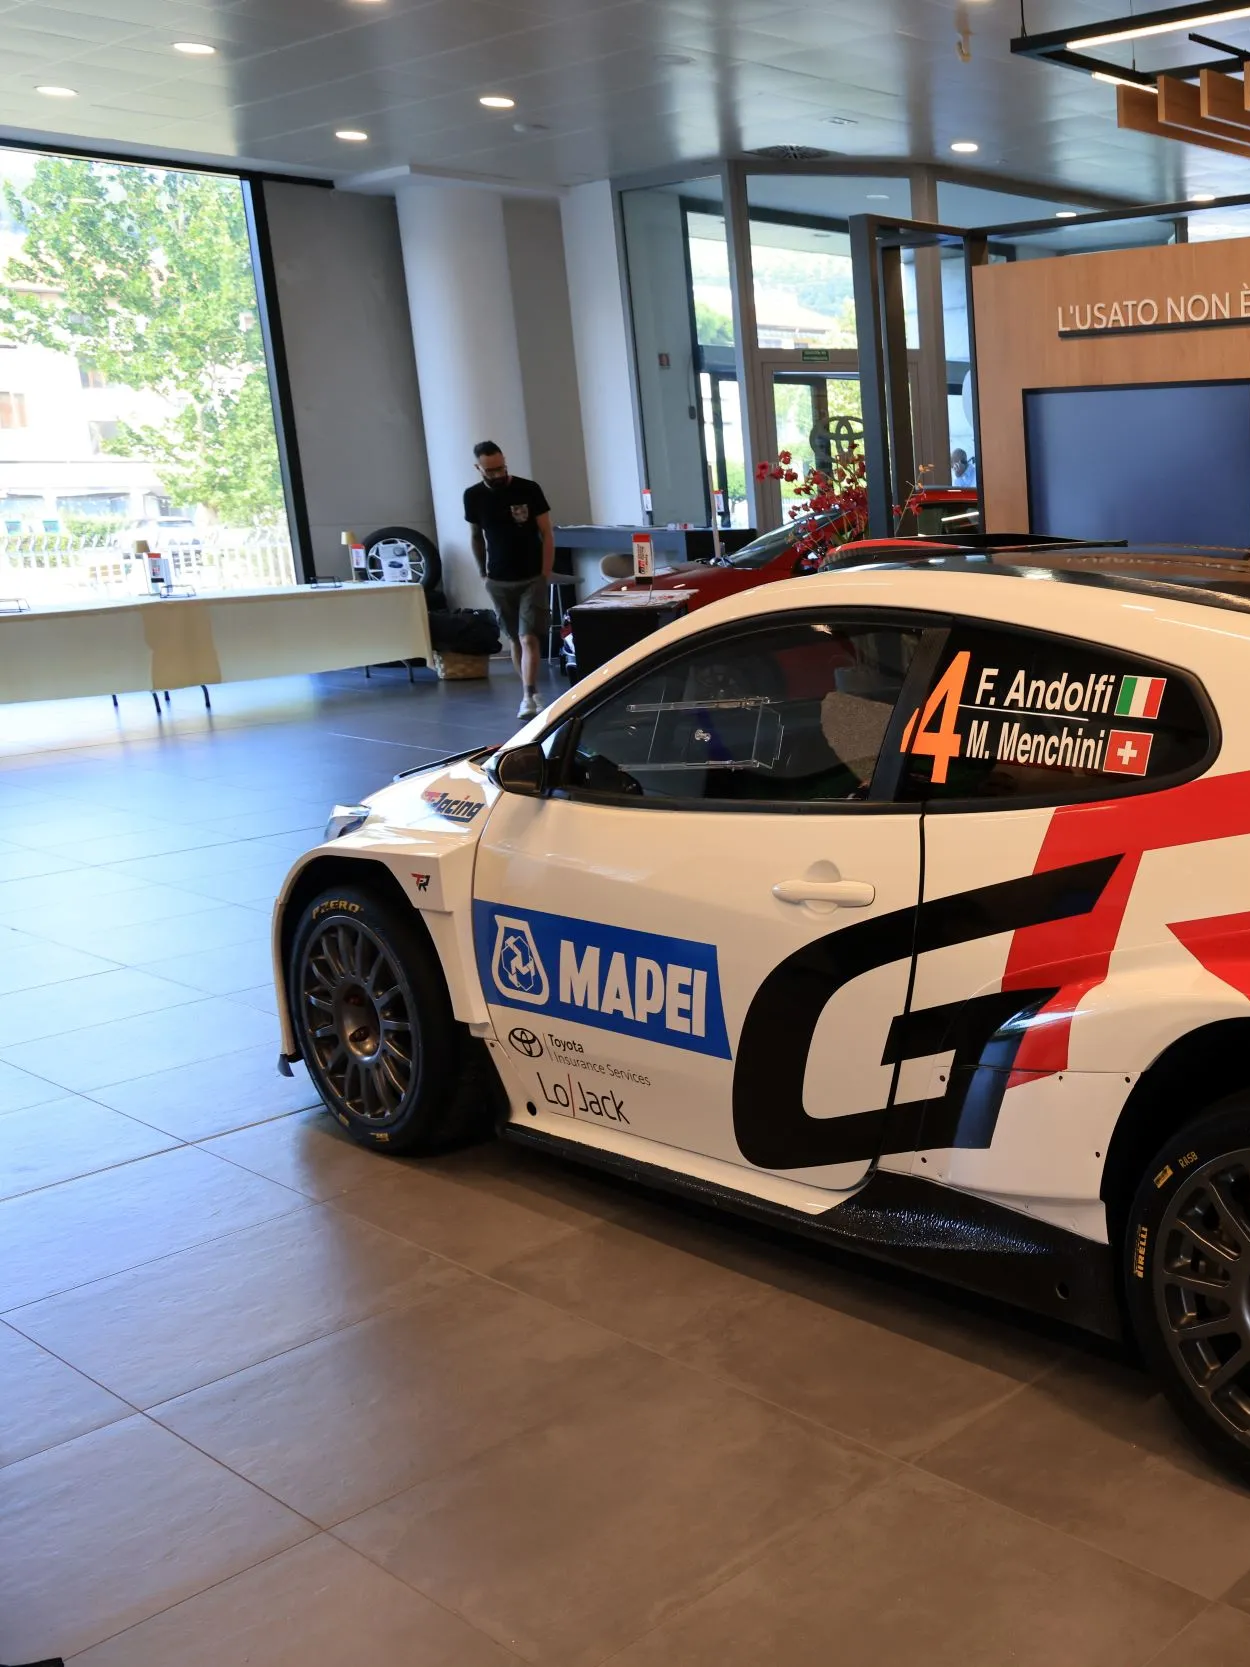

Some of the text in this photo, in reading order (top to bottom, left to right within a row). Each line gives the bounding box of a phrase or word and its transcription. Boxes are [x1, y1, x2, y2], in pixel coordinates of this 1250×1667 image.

[1057, 298, 1160, 332] L'USATO
[1166, 292, 1231, 324] NON
[974, 668, 1116, 714] F. Andolfi
[900, 651, 971, 784] 4
[965, 720, 1106, 769] M. Menchini
[559, 938, 708, 1038] MAPEI
[547, 1033, 584, 1054] Toyota
[553, 1051, 605, 1075] Insurance
[606, 1063, 652, 1087] Services
